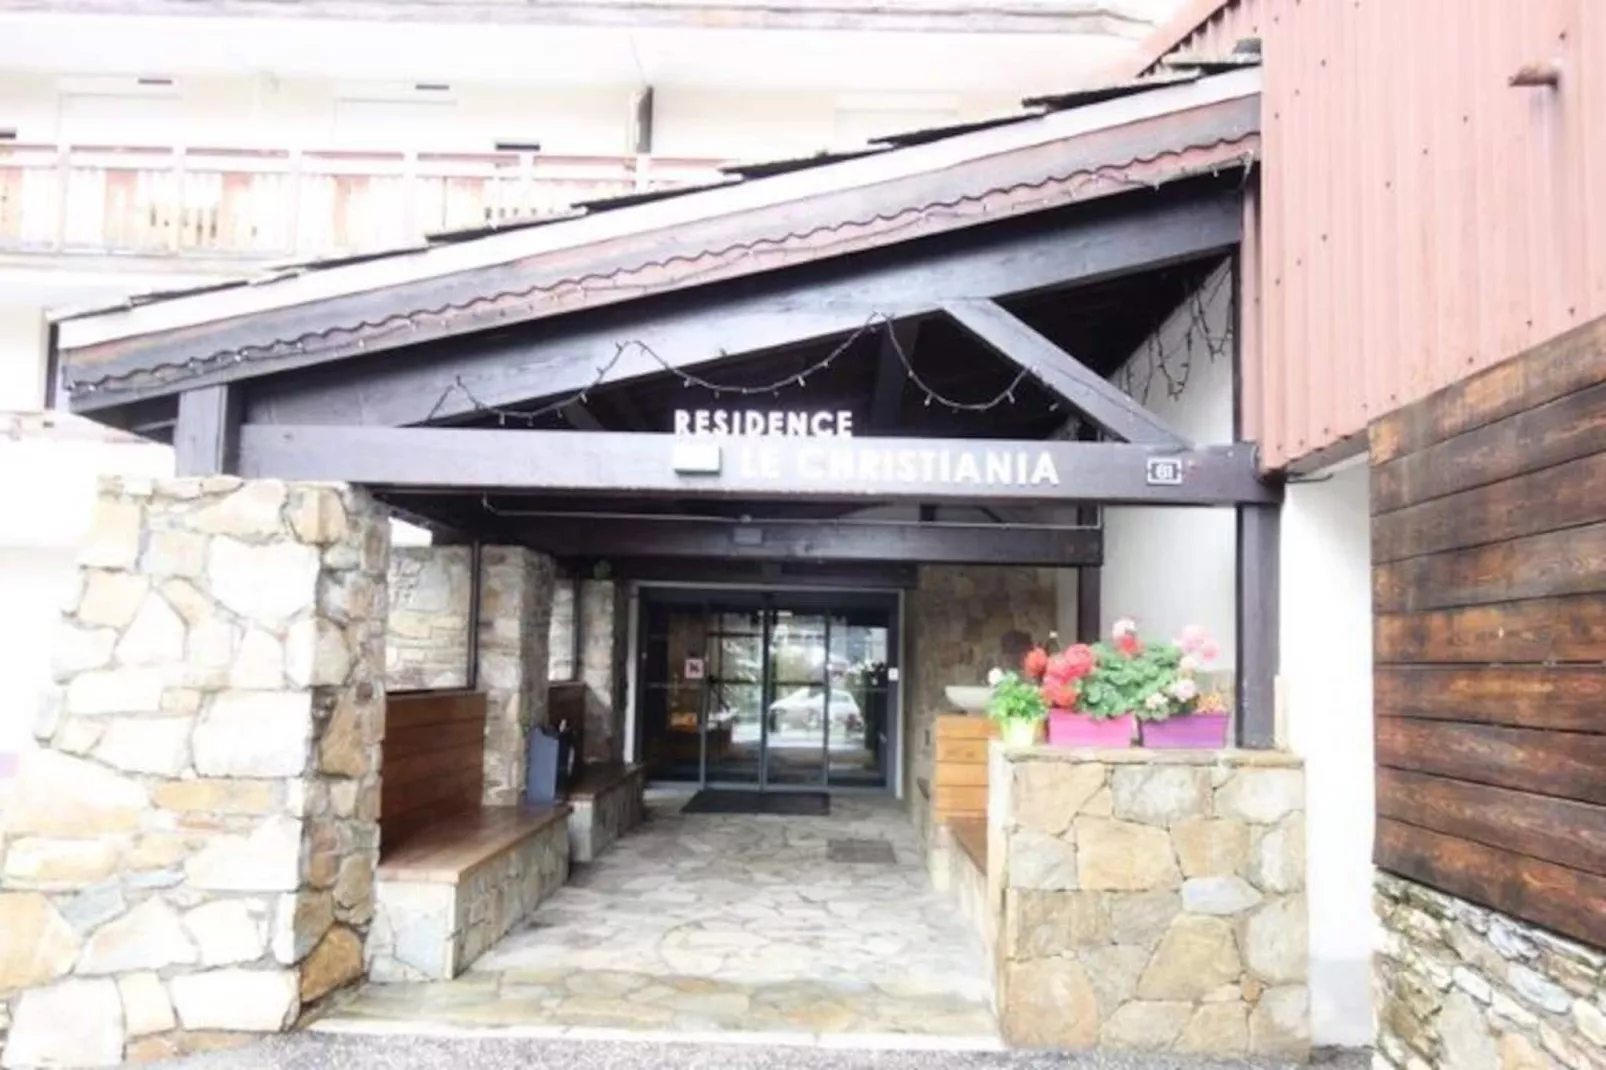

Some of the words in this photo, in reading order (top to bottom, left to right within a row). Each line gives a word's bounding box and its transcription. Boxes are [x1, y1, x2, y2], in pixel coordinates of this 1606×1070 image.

[674, 409, 853, 437] RESIDENCE
[740, 447, 780, 478] LE
[798, 447, 1060, 485] CHRISTIANIA
